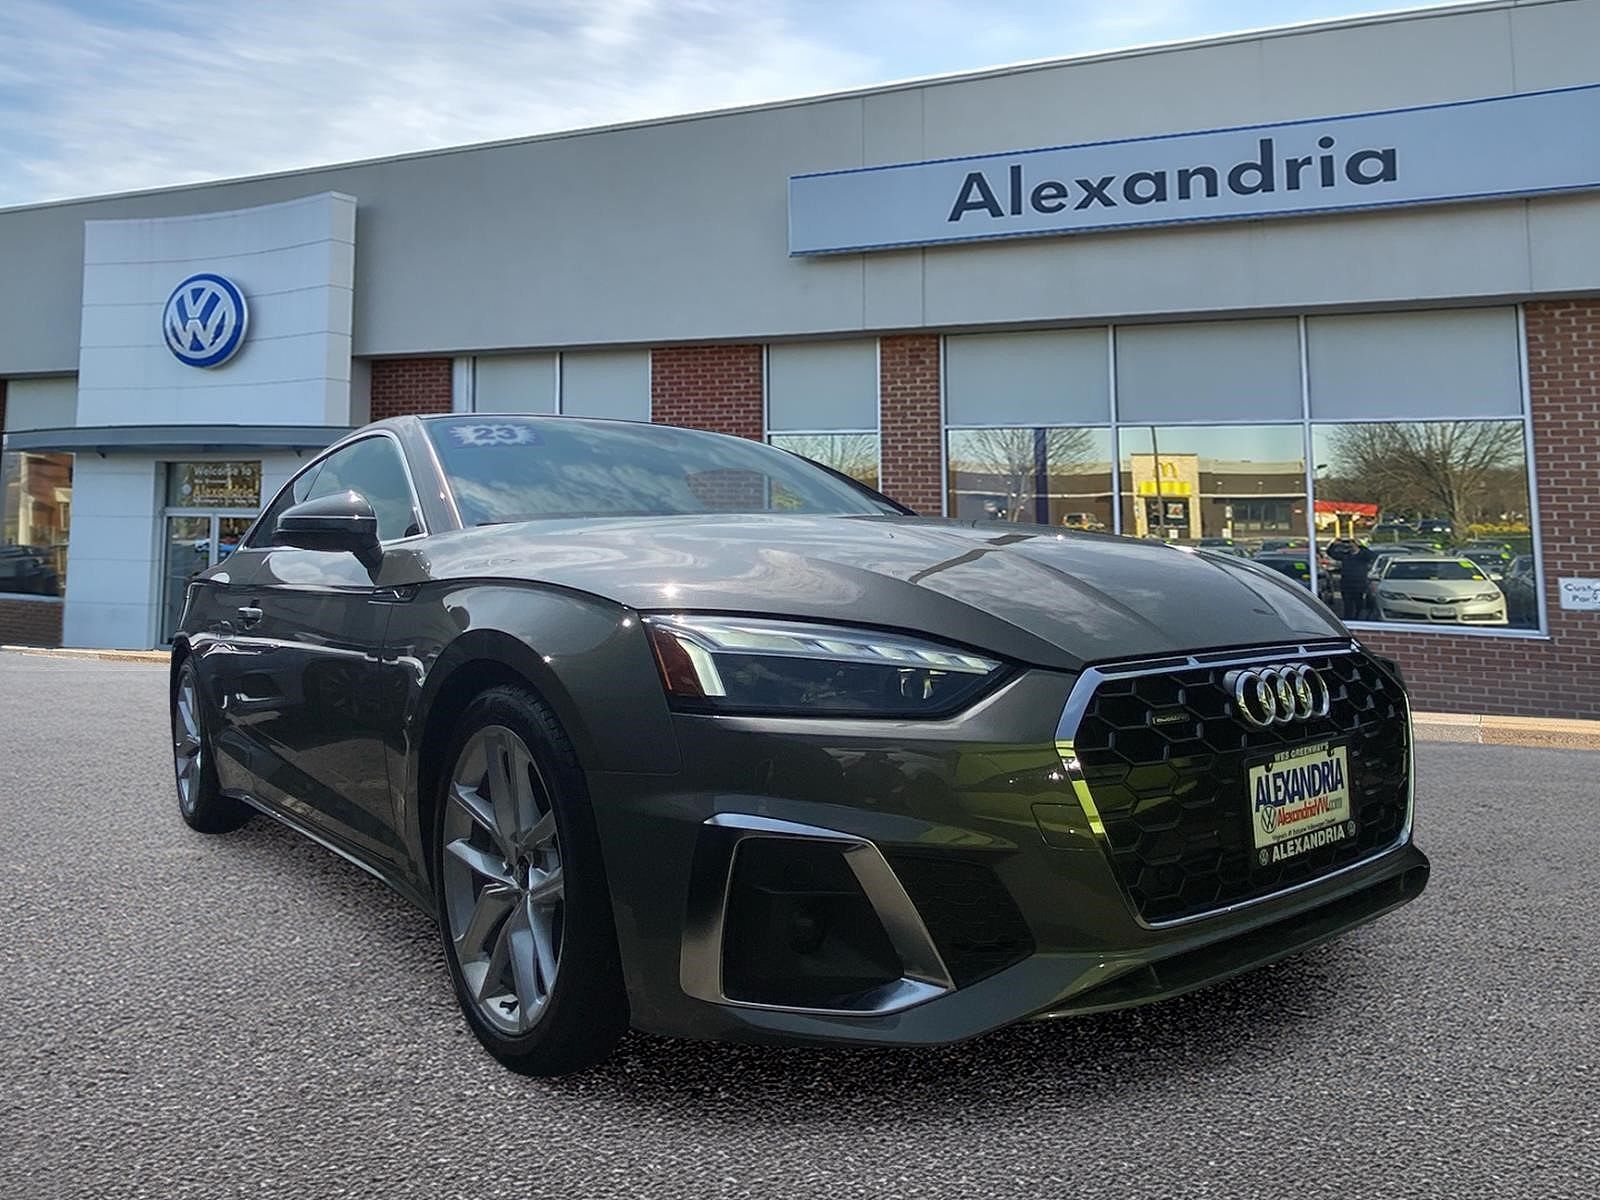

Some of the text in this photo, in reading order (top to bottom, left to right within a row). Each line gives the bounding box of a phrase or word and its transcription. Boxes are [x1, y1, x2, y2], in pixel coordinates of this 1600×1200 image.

[947, 136, 1398, 222] Alexandria
[473, 427, 518, 440] 23
[1255, 757, 1345, 813] ALEXANDRIA
[1272, 824, 1346, 863] ALEXANDRIA
